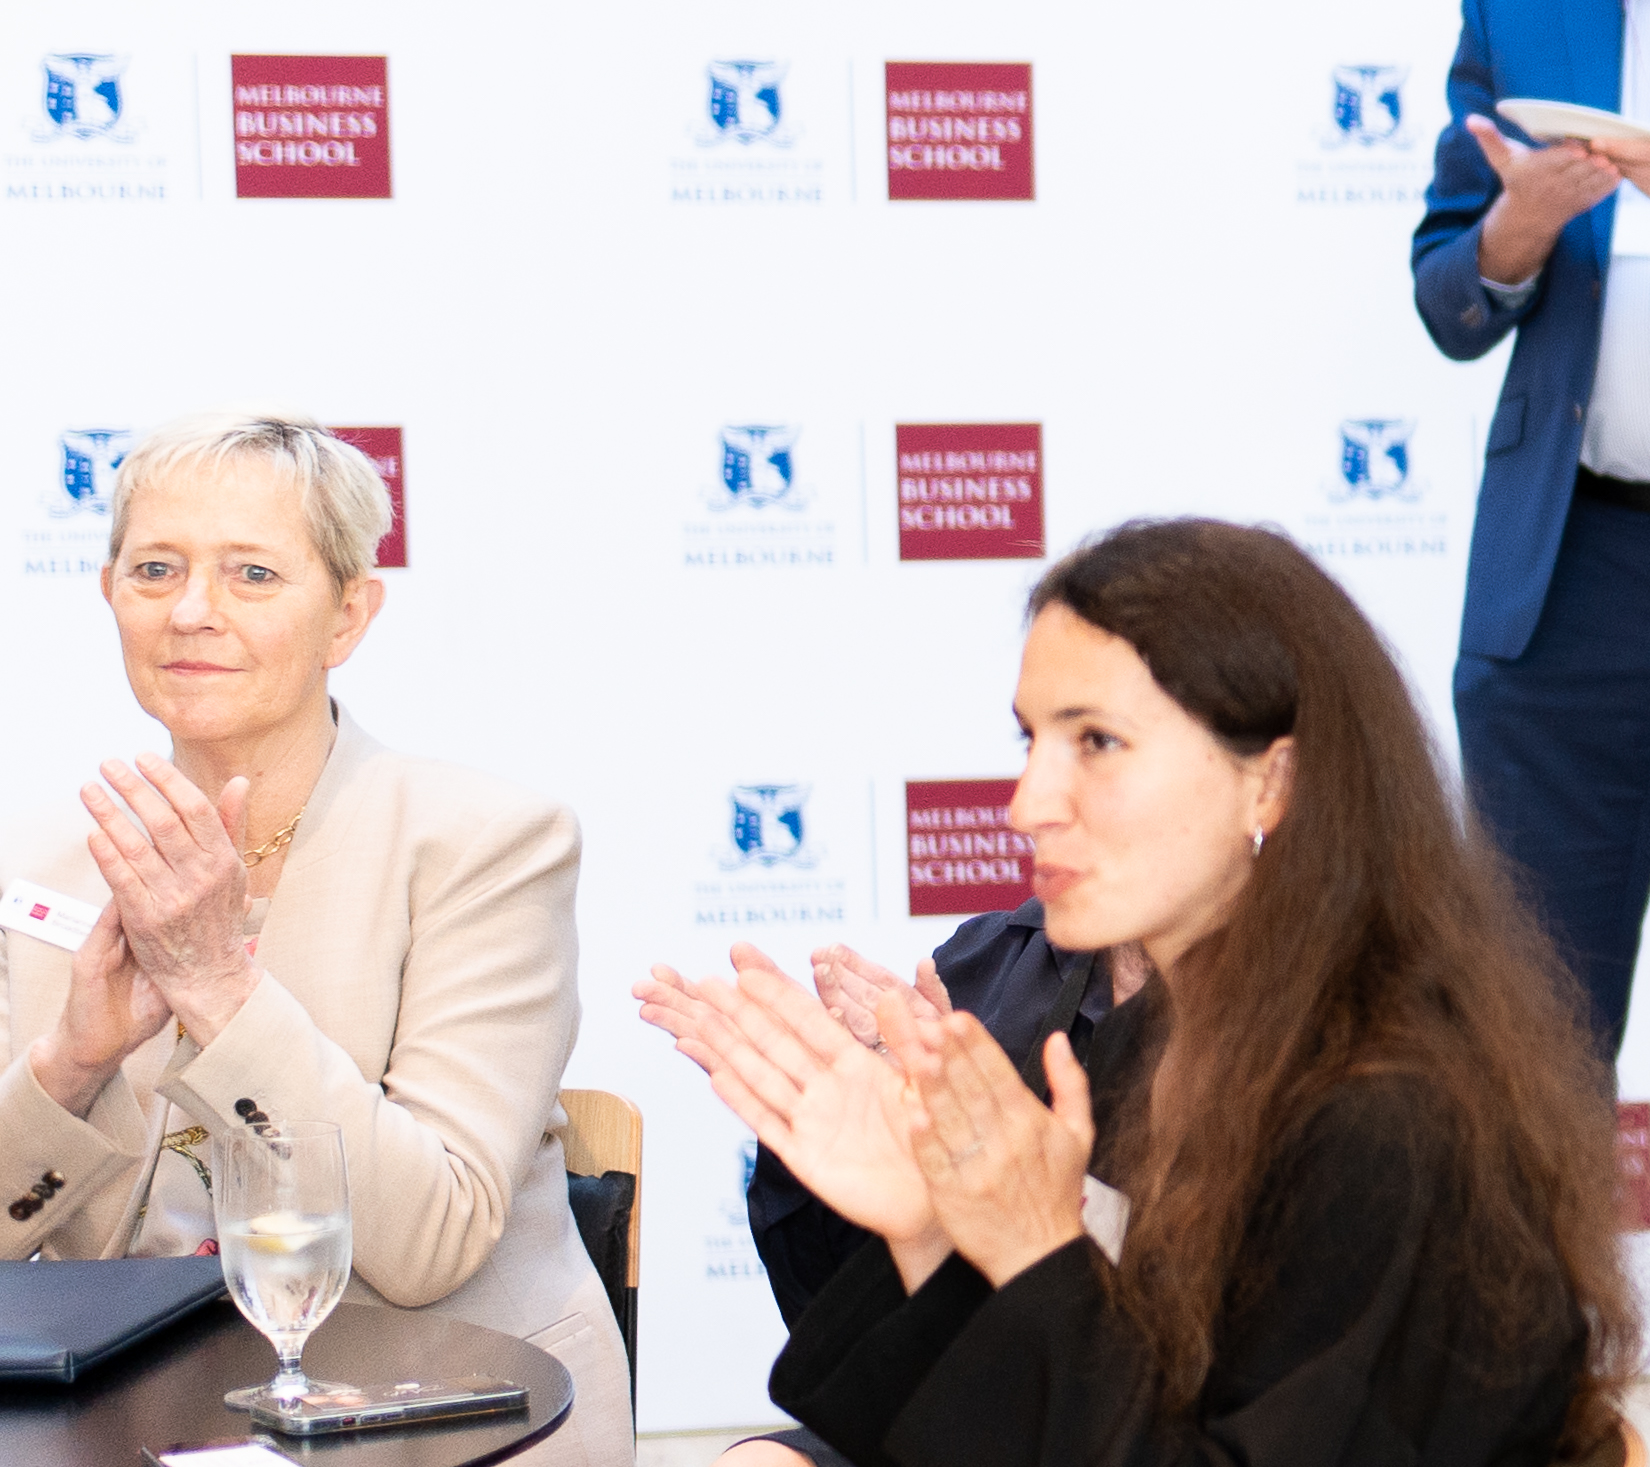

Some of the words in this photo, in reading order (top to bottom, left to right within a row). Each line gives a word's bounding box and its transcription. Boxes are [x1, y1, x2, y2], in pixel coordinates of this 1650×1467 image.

[234, 85, 384, 108] MELBOURNE
[889, 90, 1027, 113] MELBOURNE
[236, 111, 377, 138] BUSINESS
[889, 116, 1022, 143] BUSINESS
[236, 140, 361, 167] SCHOOL
[889, 144, 1006, 171] SCHOOL
[900, 451, 1036, 473] MELBOURNE
[900, 476, 1032, 503] BUSINESS
[900, 504, 1017, 530] SCHOOL
[910, 859, 1023, 887] SCHOOL
[696, 906, 844, 924] MELBOURNE
